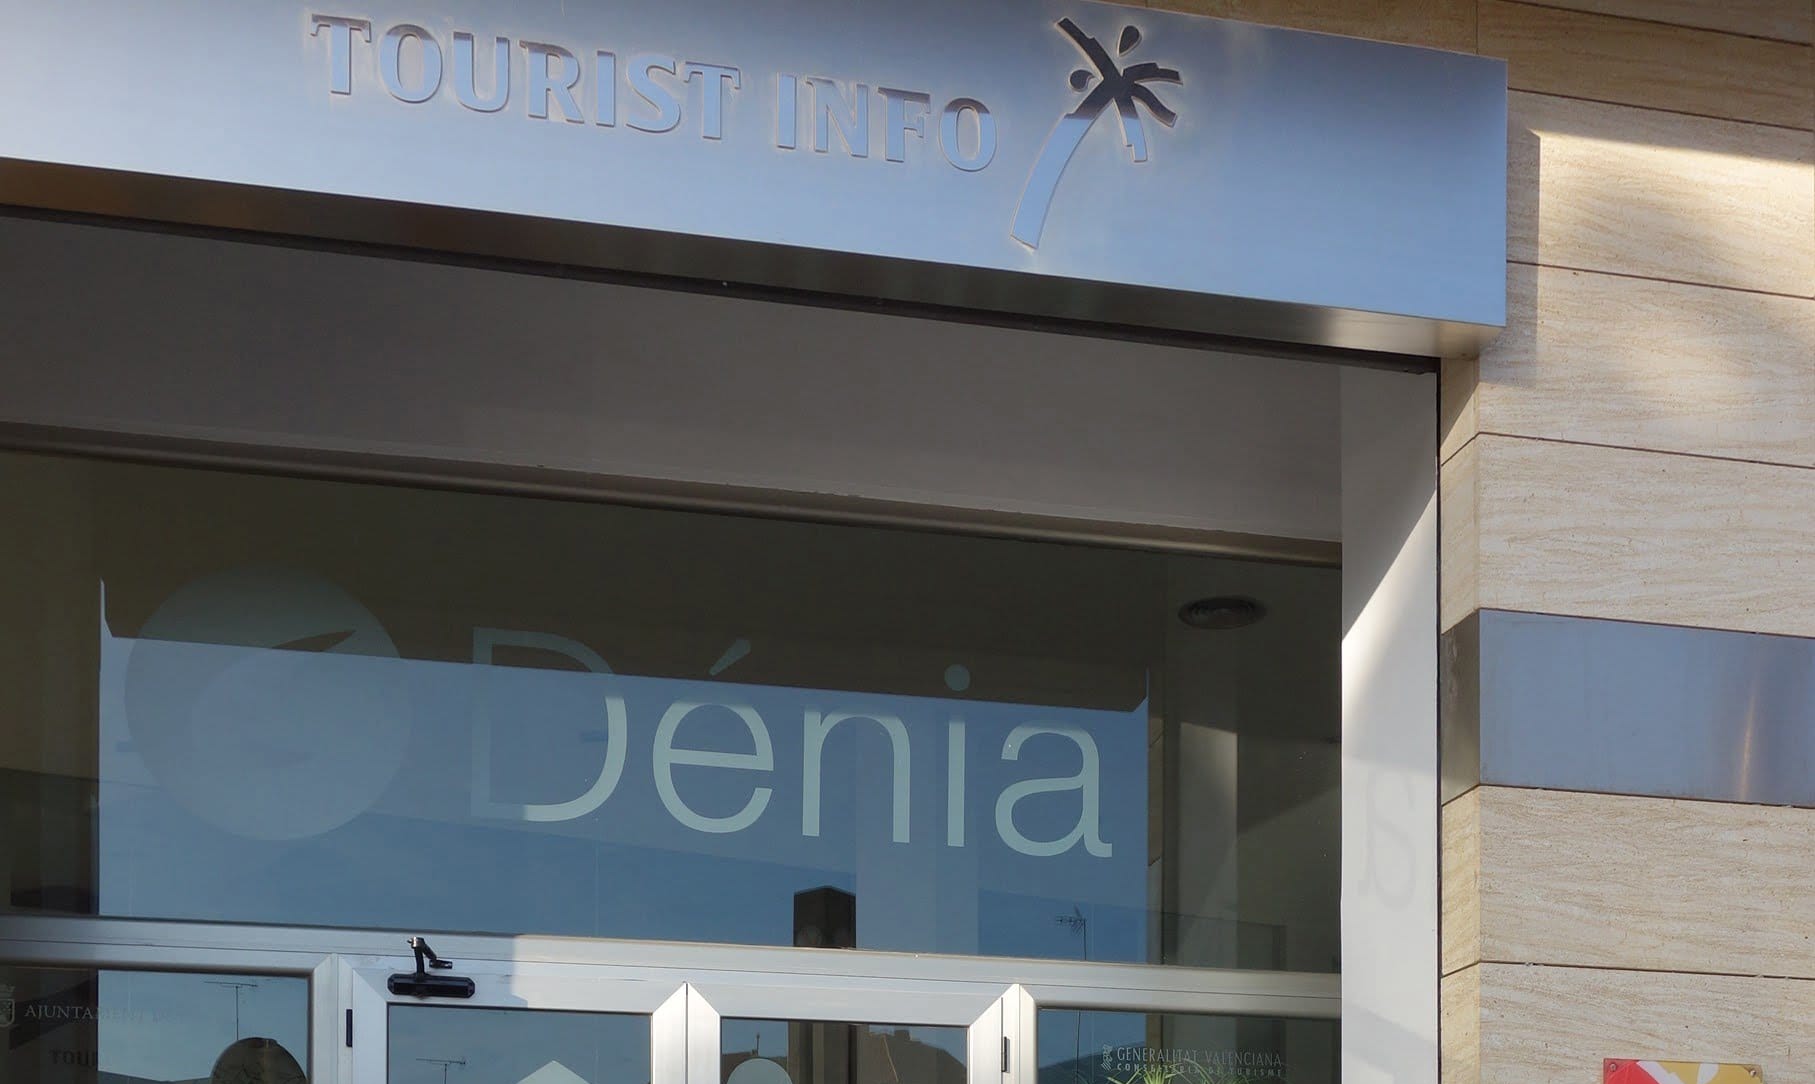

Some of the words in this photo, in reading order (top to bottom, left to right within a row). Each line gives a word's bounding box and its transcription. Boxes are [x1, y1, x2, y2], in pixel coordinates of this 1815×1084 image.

[309, 13, 740, 140] TOURIST
[776, 72, 997, 173] INFO
[471, 626, 1113, 858] Dénia
[1205, 1050, 1281, 1067] VALENCIANA
